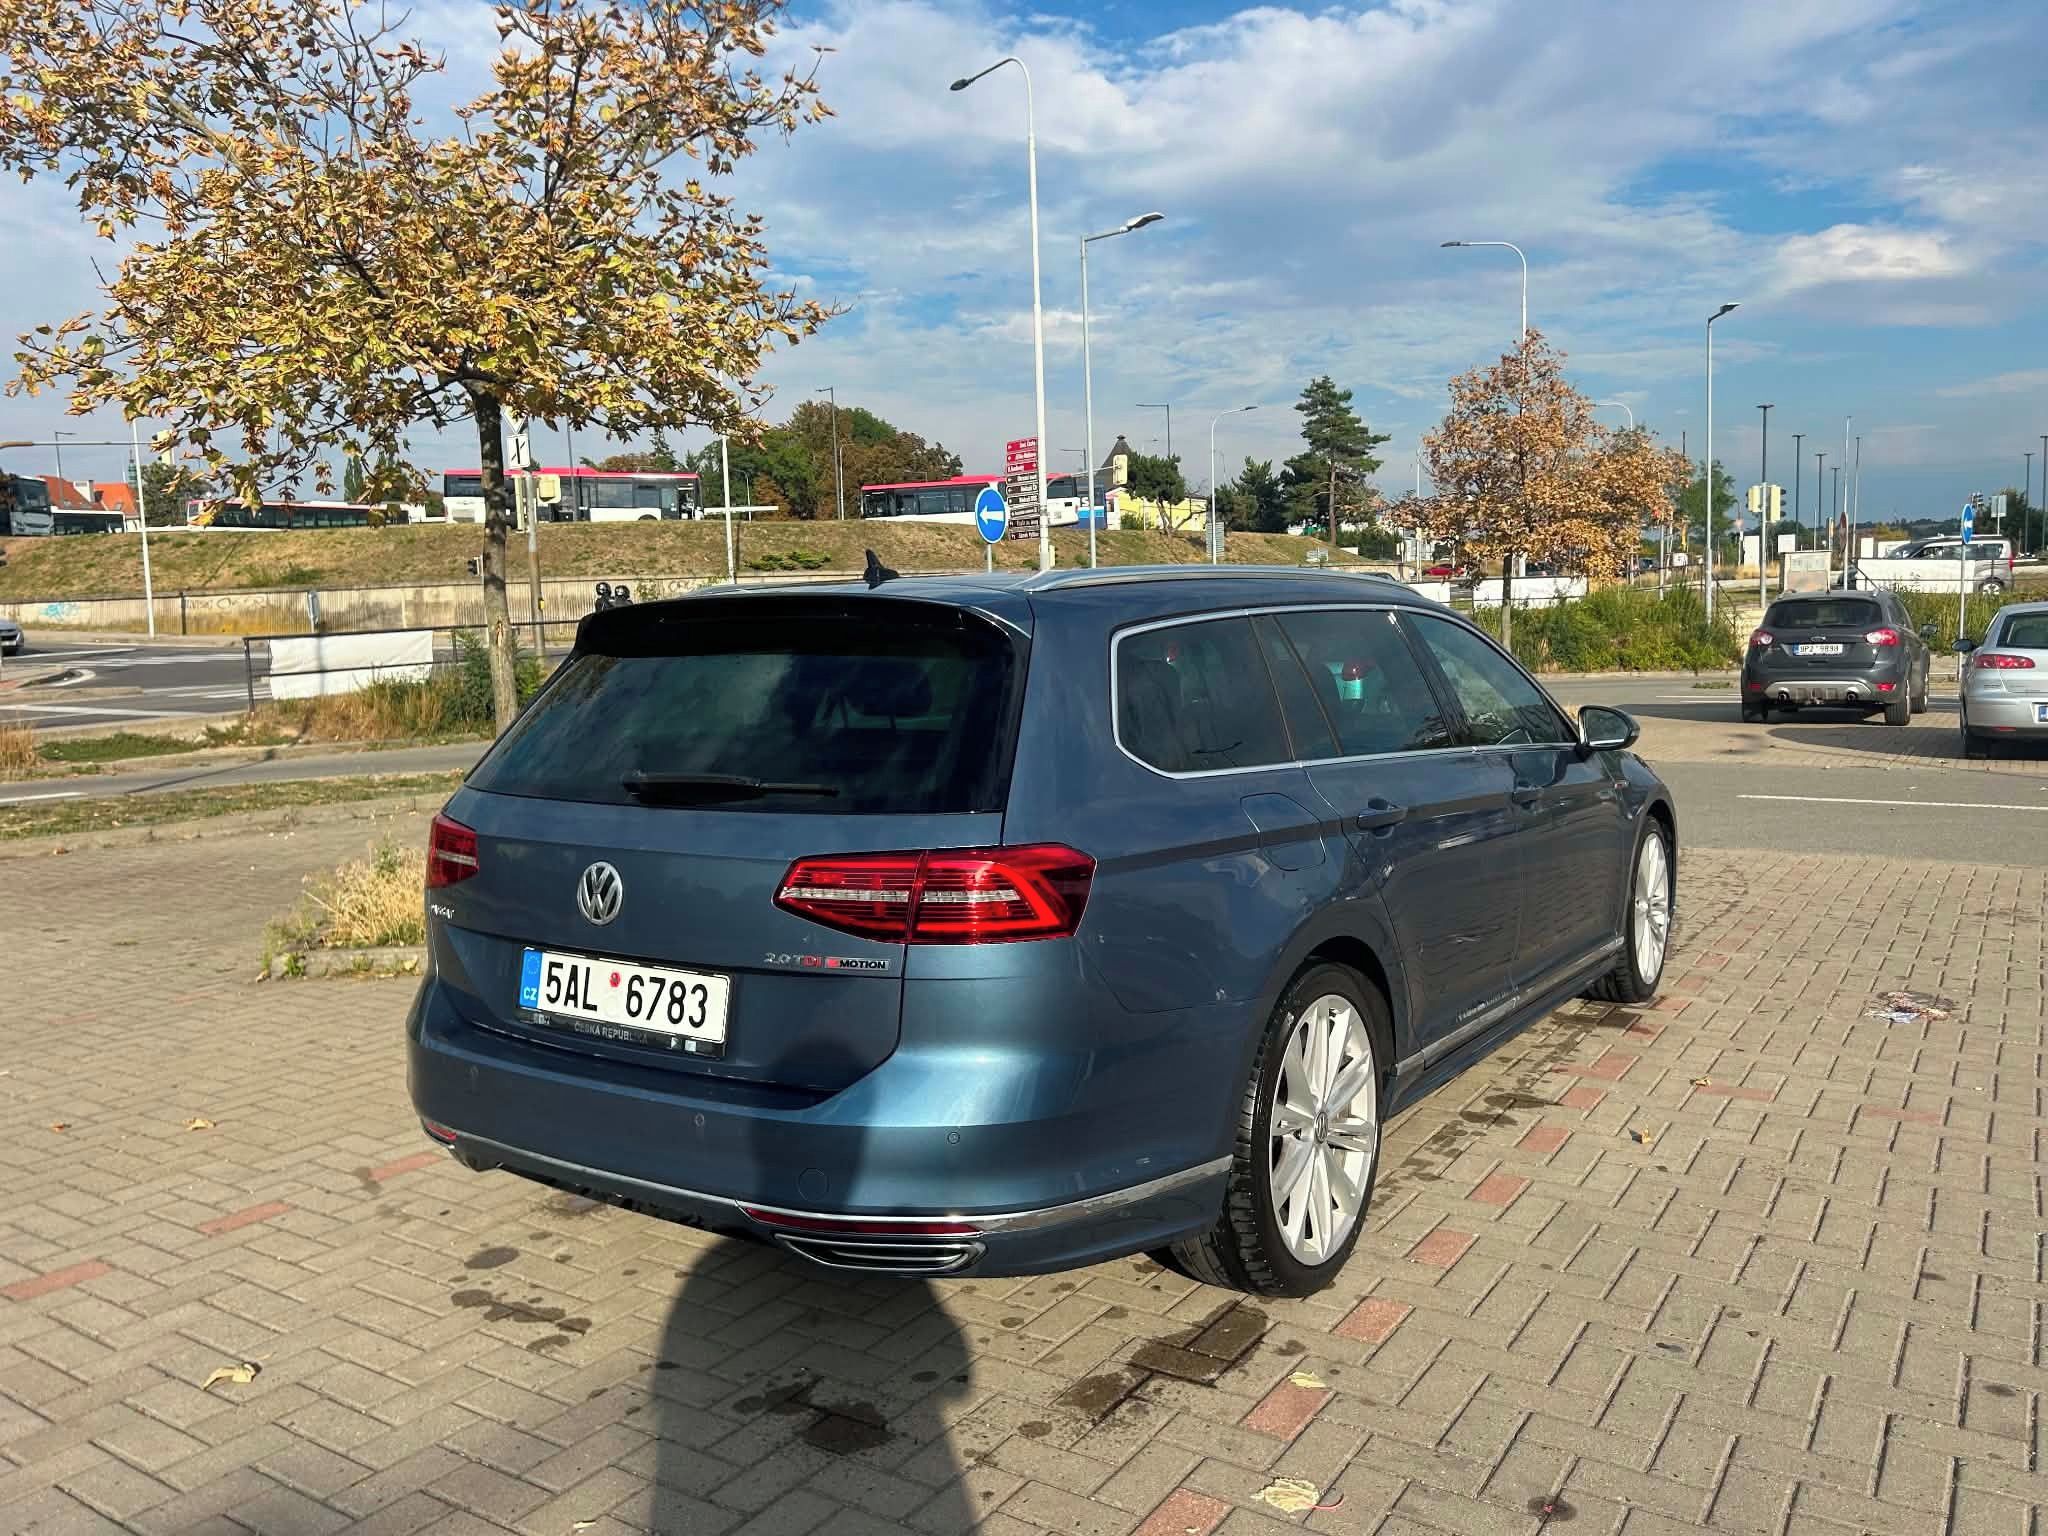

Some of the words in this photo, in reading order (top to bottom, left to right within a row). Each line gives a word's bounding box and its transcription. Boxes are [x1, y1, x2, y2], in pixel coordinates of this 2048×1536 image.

[524, 986, 538, 1001] CZ
[546, 961, 598, 1012] 5AL
[625, 974, 708, 1028] 6783
